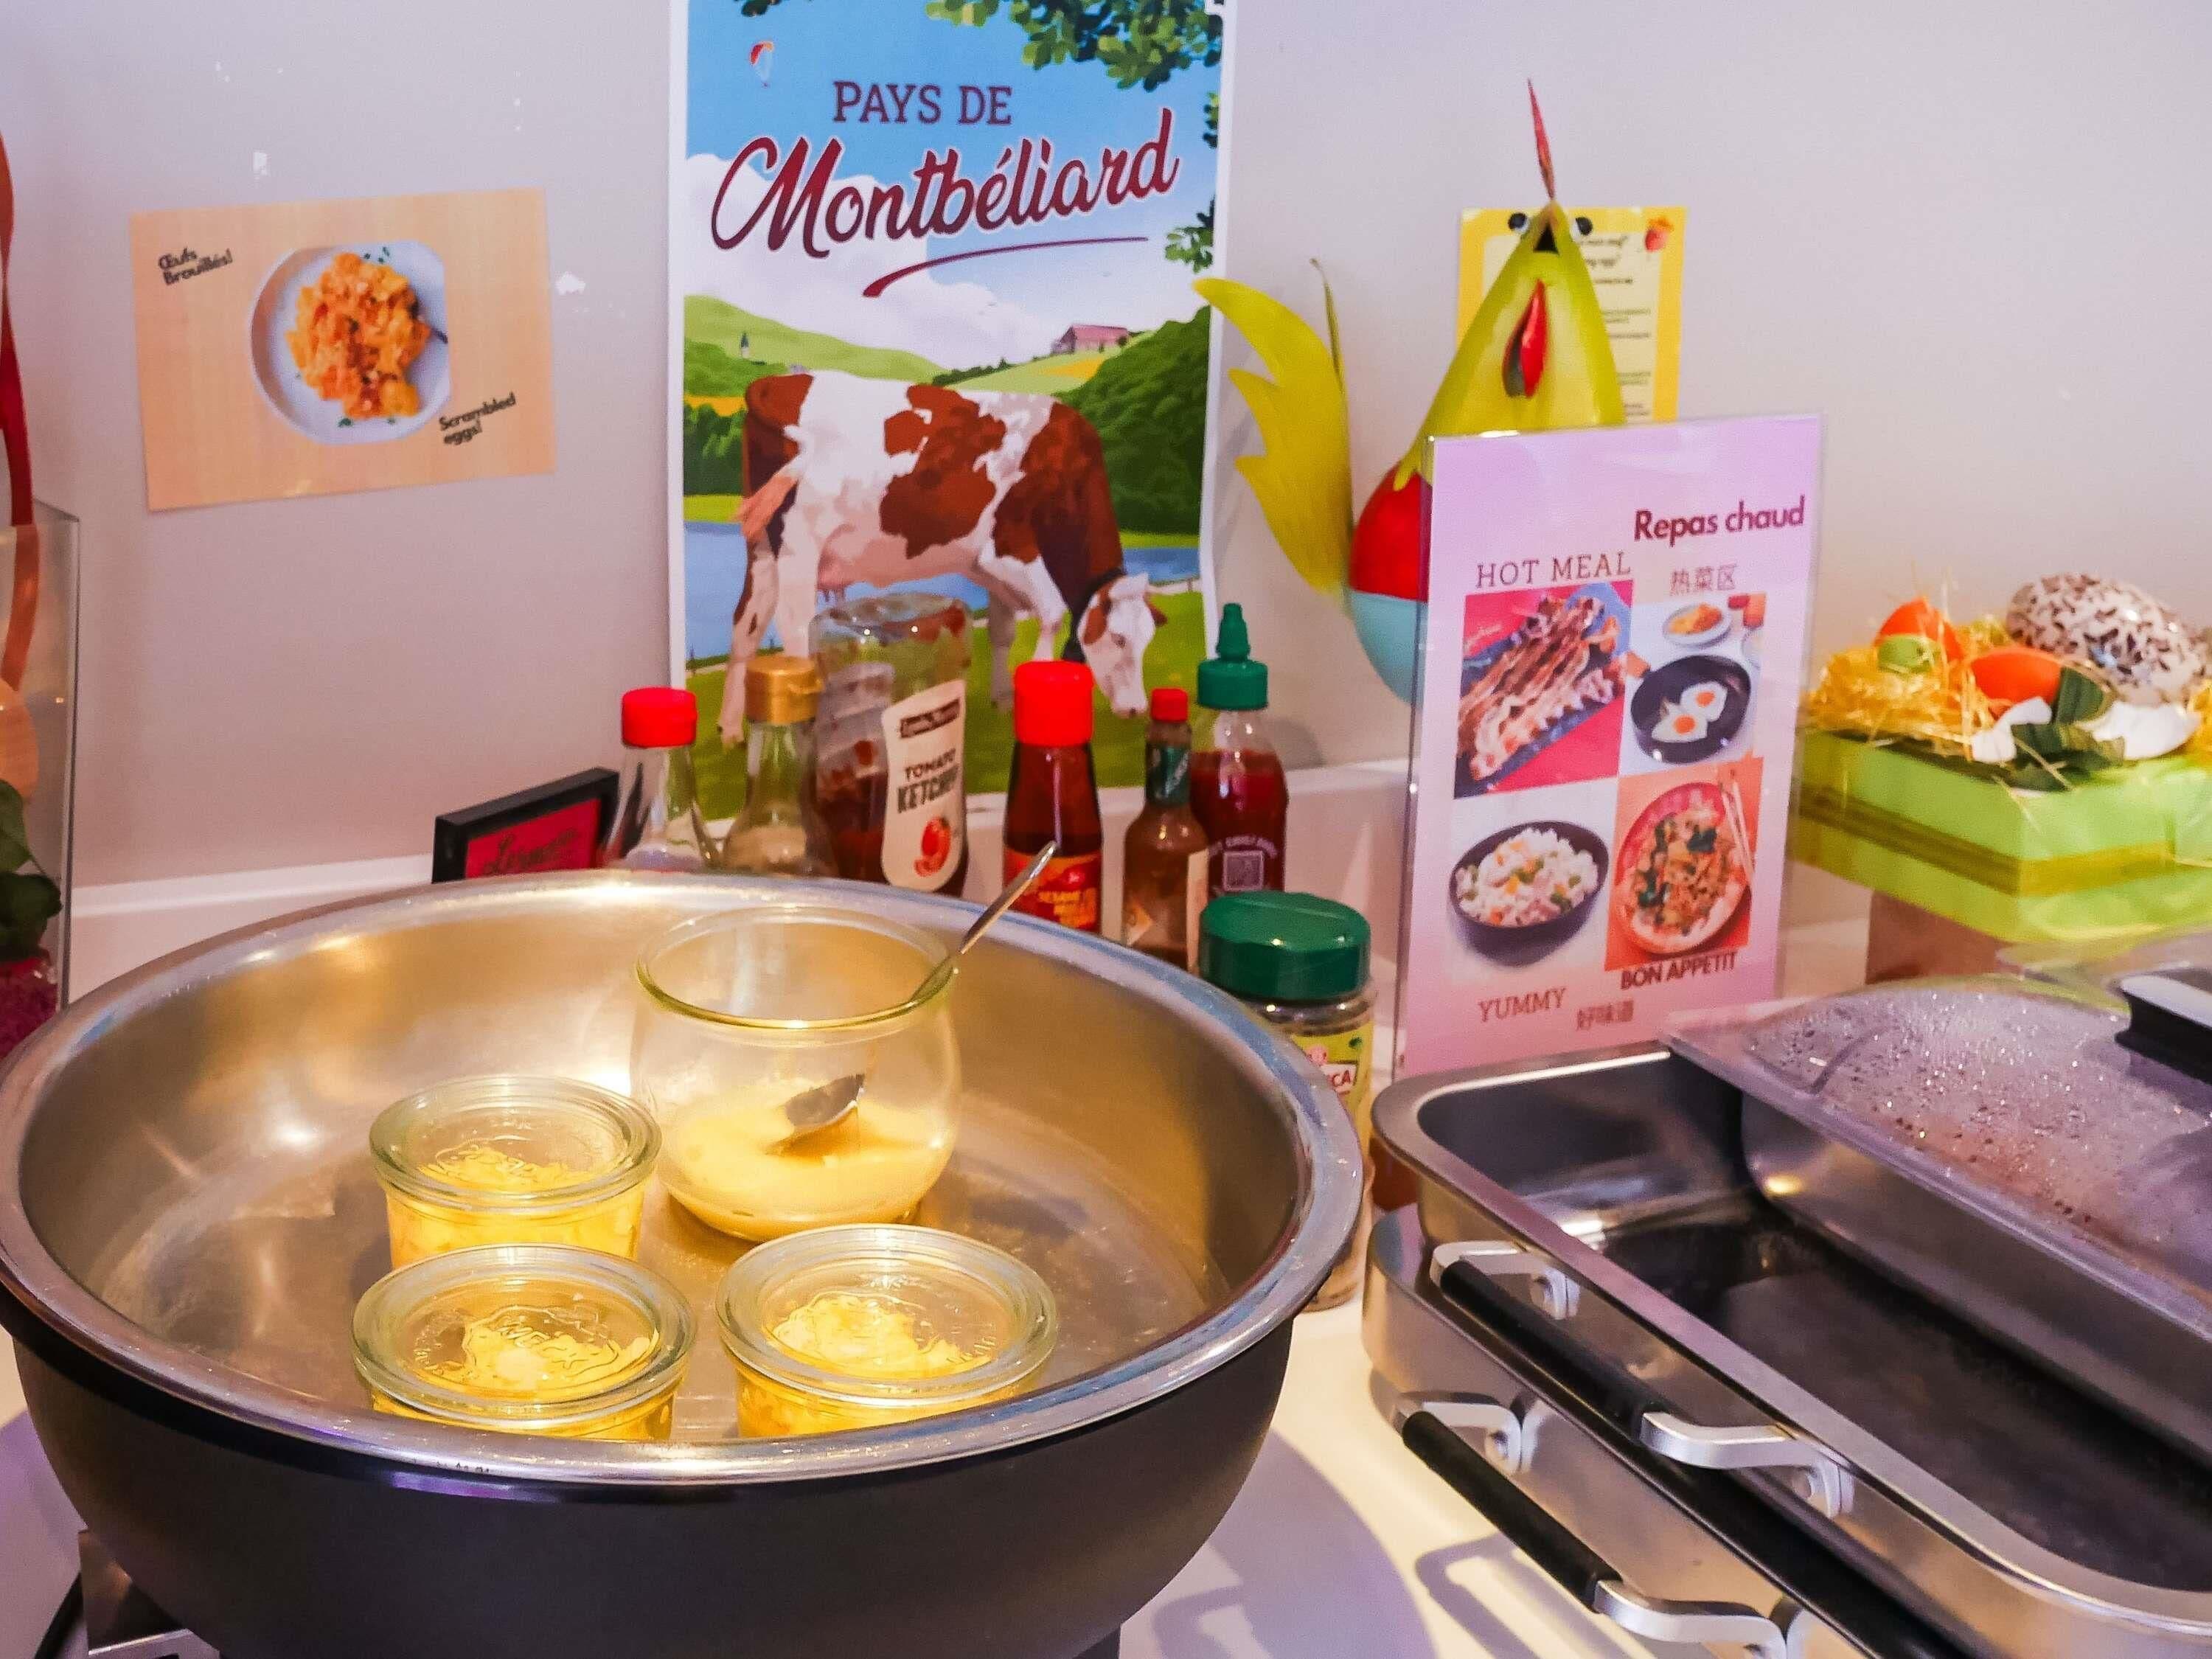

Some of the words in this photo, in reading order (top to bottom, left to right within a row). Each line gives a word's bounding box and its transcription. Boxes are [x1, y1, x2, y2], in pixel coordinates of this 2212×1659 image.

[833, 80, 942, 124] PAYS
[958, 85, 1013, 126] DE
[710, 107, 1180, 259] Montbéliard
[439, 392, 516, 431] Scrambled
[1634, 509, 1718, 548] Repas
[1725, 495, 1805, 532] chaud
[1476, 559, 1540, 588] HOT
[1551, 551, 1632, 582] MEAL
[1621, 961, 1663, 990] BON
[1667, 951, 1738, 981] APPETIT
[1478, 988, 1567, 1023] YUMMY
